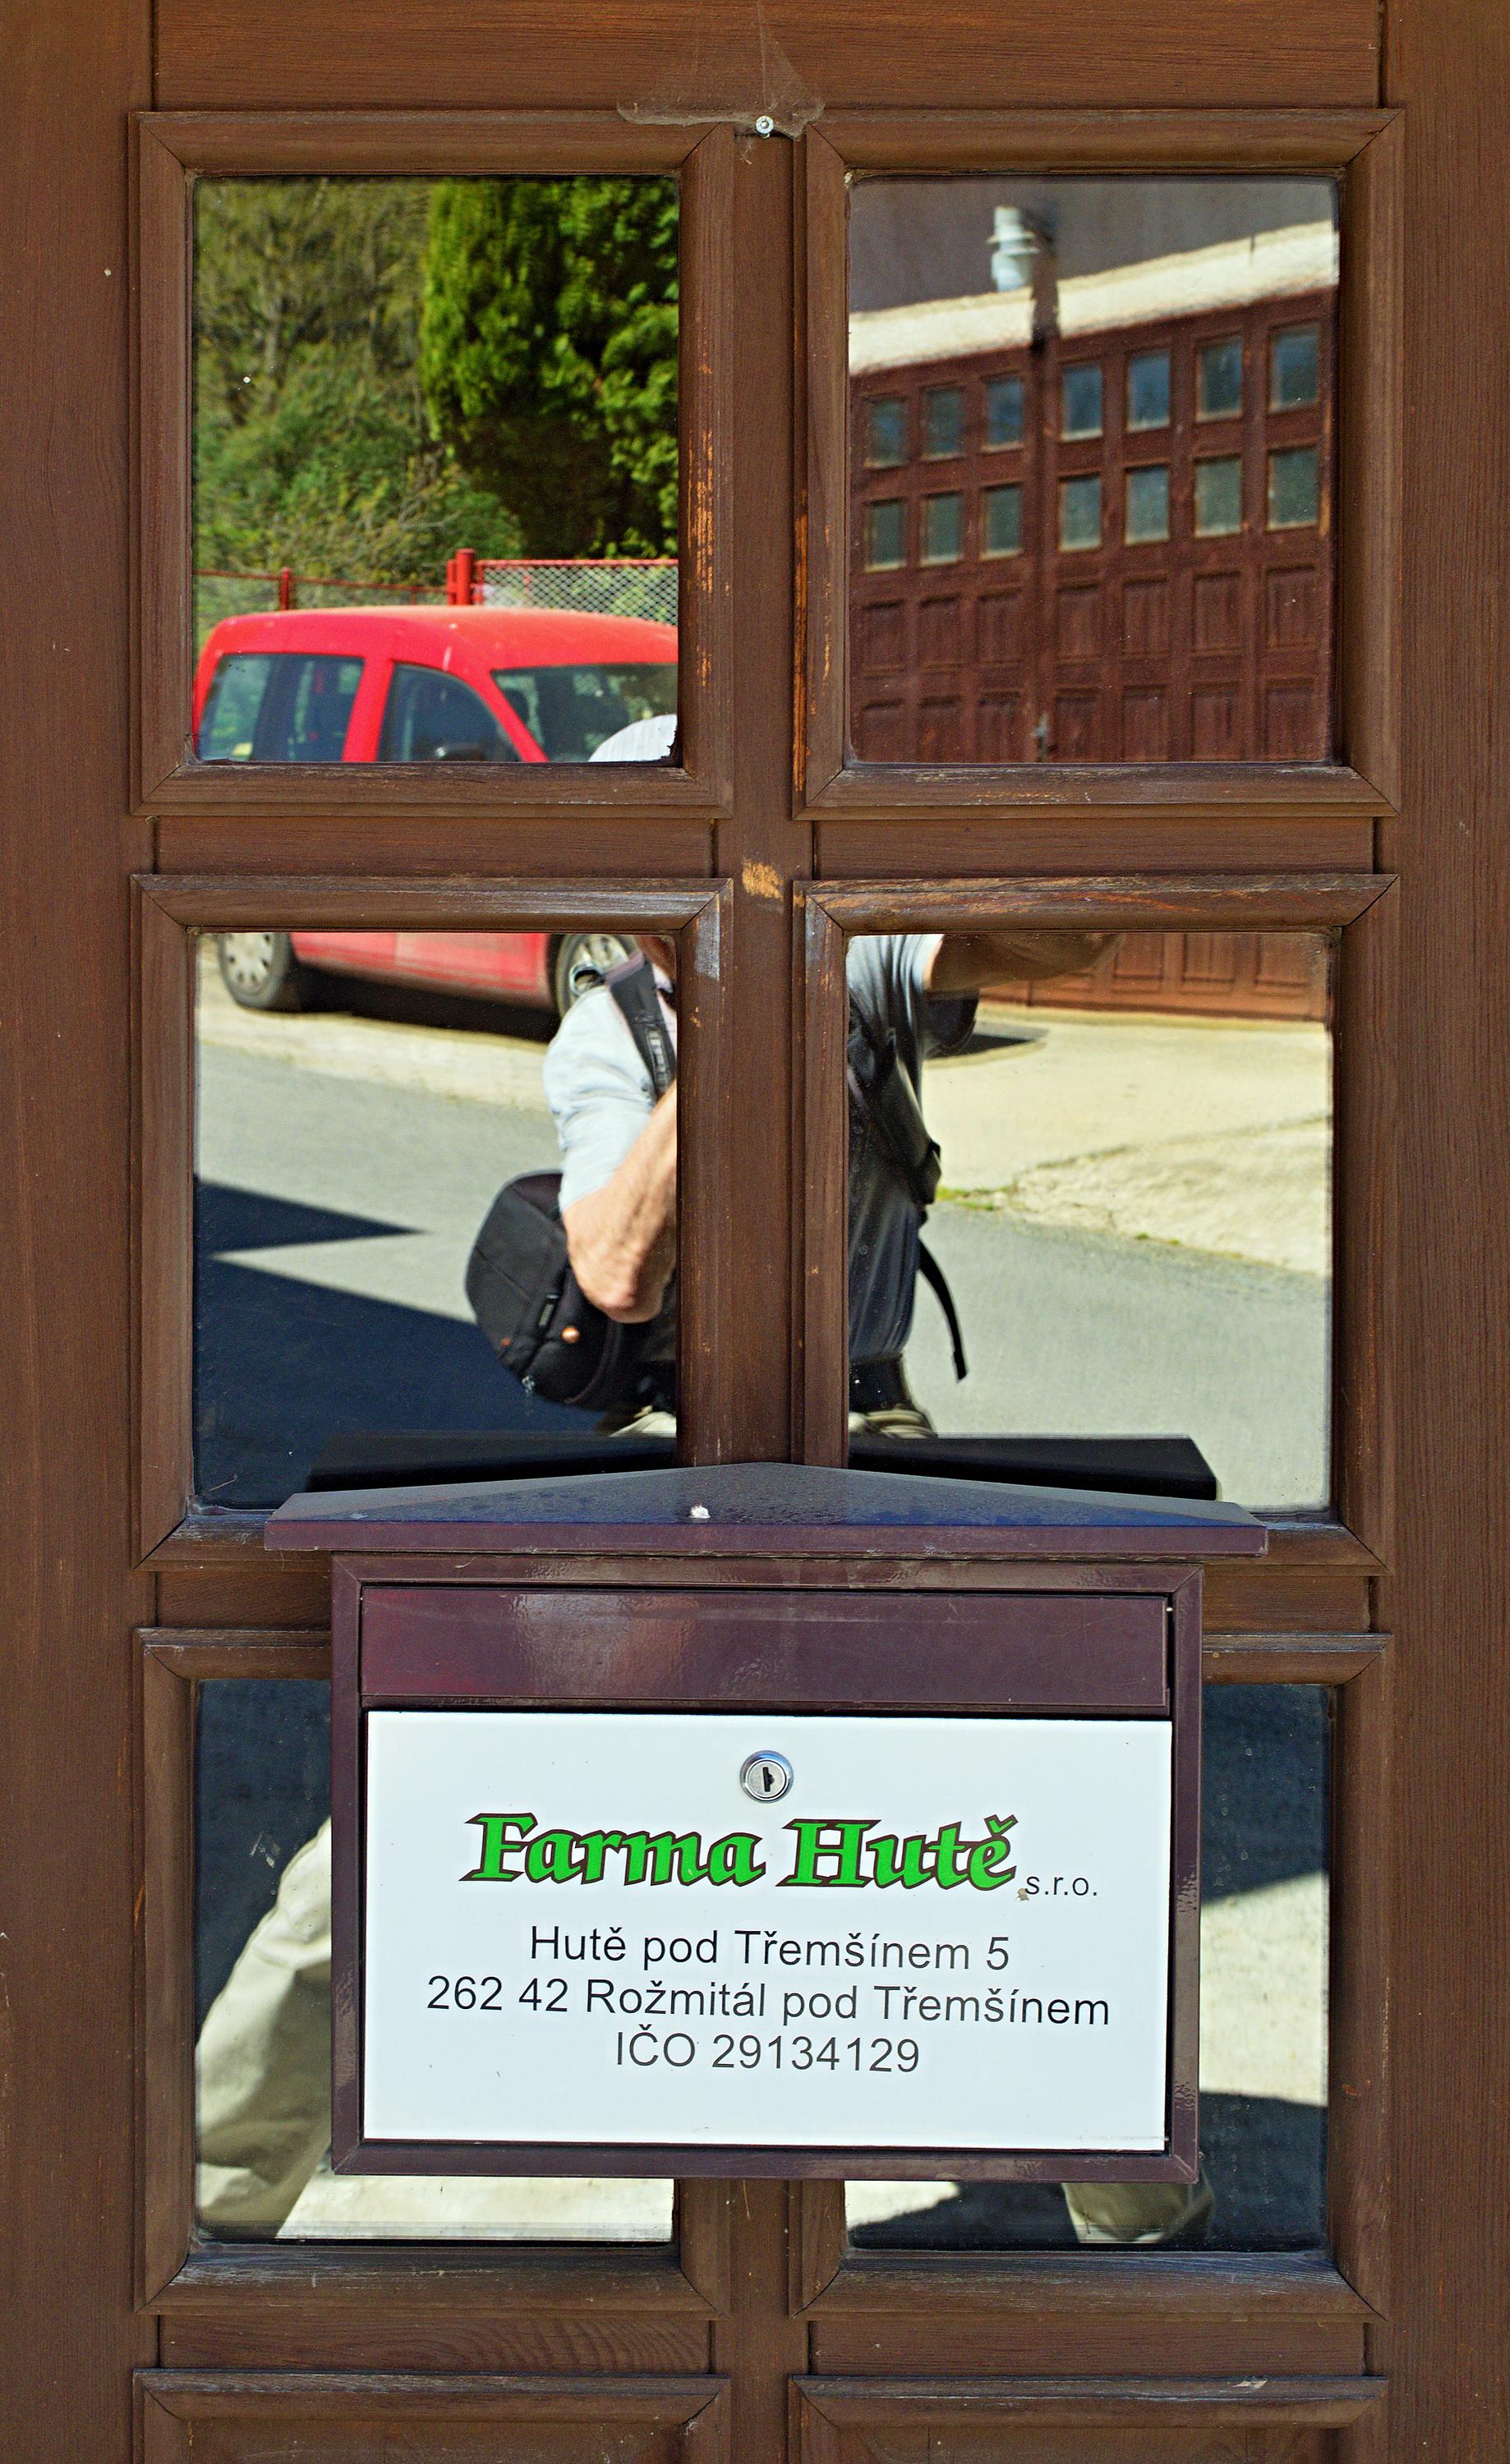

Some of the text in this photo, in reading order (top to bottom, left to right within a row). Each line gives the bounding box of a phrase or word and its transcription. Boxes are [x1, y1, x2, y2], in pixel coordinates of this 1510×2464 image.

[458, 1812, 1098, 1896] Farma Hutě s.r.o.
[531, 1924, 1009, 1971] Hutě pod Třemšínem 5
[427, 1975, 1109, 2026] 262 42 Rožmitál pod Třemšínem
[617, 2023, 919, 2073] IČO 29134129
